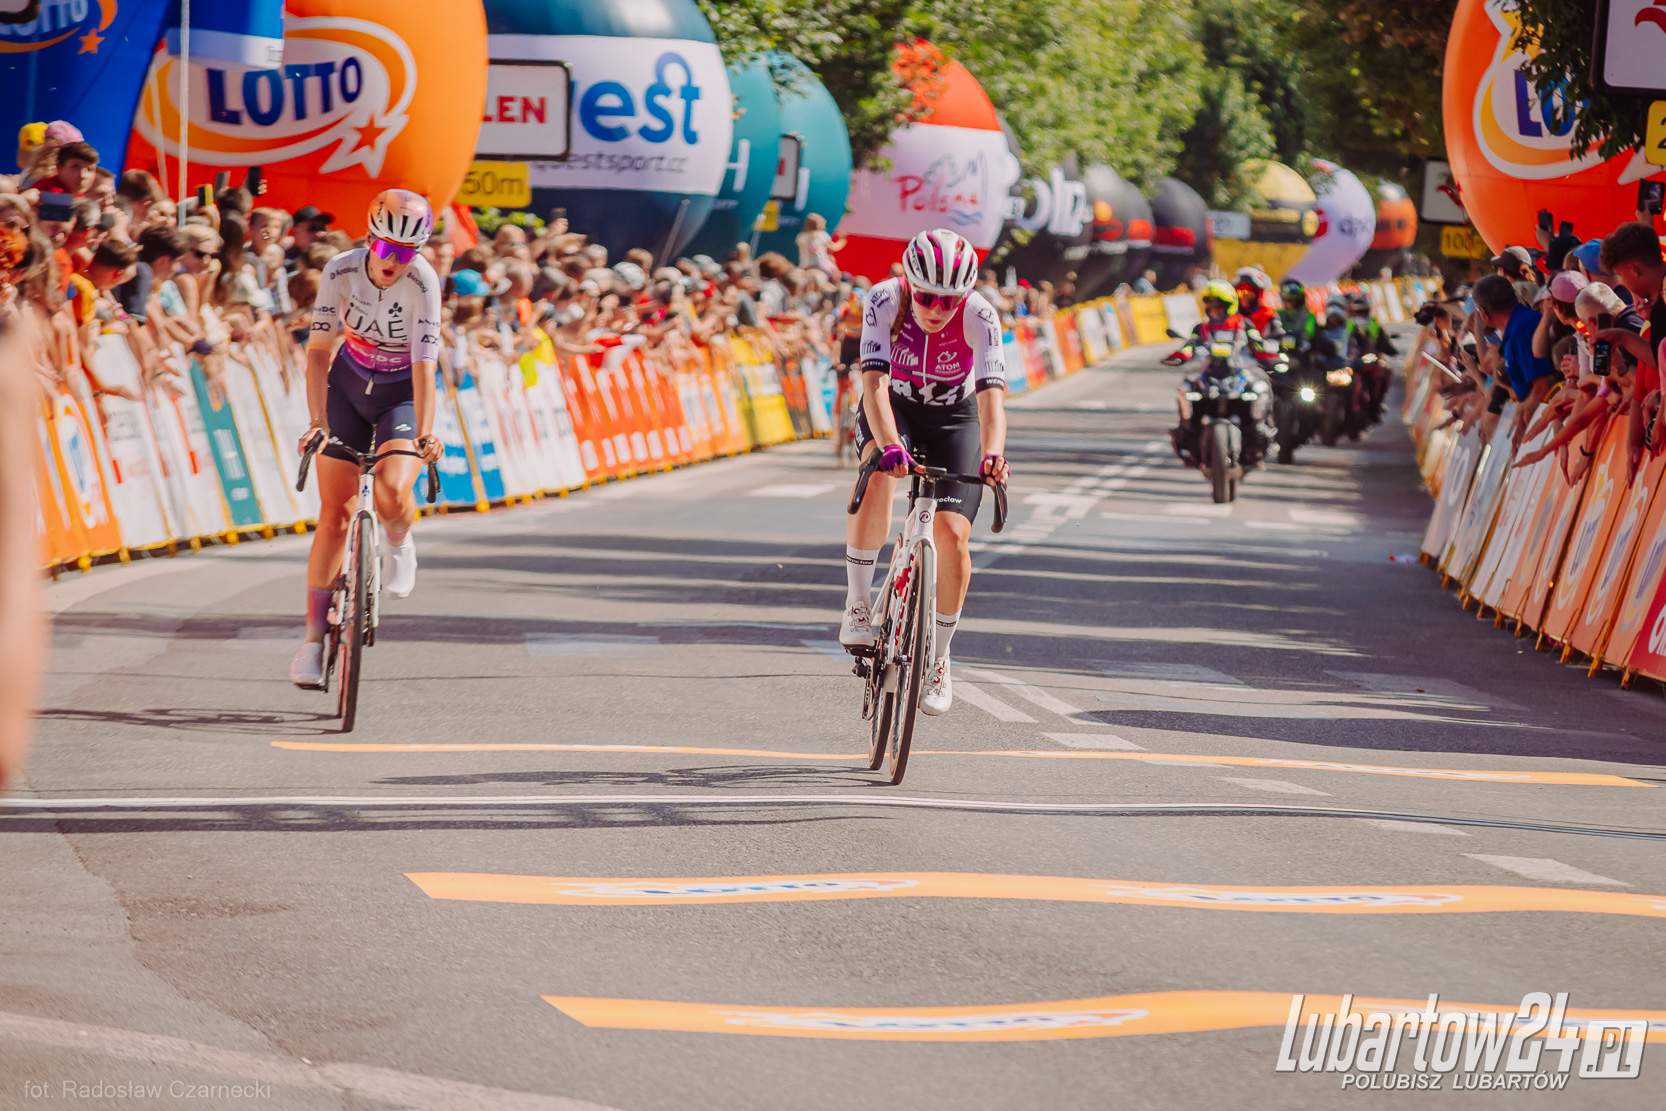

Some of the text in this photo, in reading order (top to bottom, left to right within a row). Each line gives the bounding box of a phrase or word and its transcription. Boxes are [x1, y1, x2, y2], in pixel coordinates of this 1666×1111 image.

[206, 56, 363, 126] LOTTO
[570, 52, 701, 145] est
[344, 307, 408, 339] UAE
[935, 362, 960, 372] ATOM
